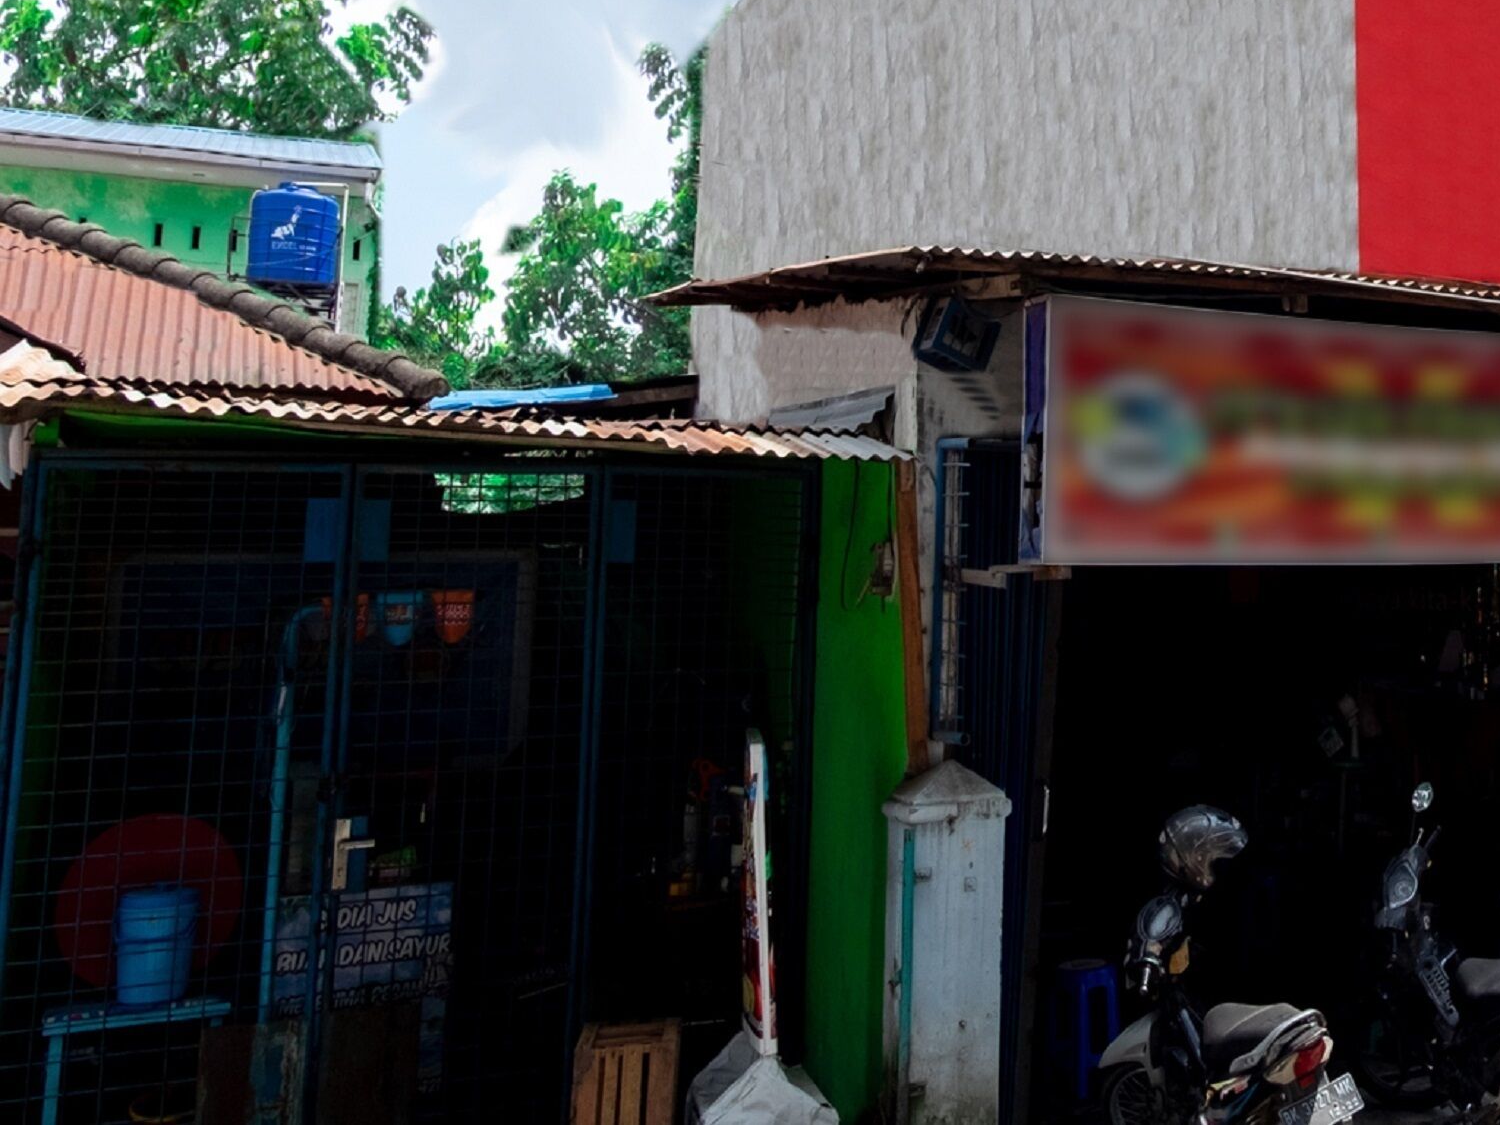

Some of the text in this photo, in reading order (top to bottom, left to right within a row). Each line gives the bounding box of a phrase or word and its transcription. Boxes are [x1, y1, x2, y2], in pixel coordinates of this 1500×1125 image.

[377, 899, 417, 924] JUS
[339, 940, 384, 966] DAN
[385, 933, 453, 961] SAYUR
